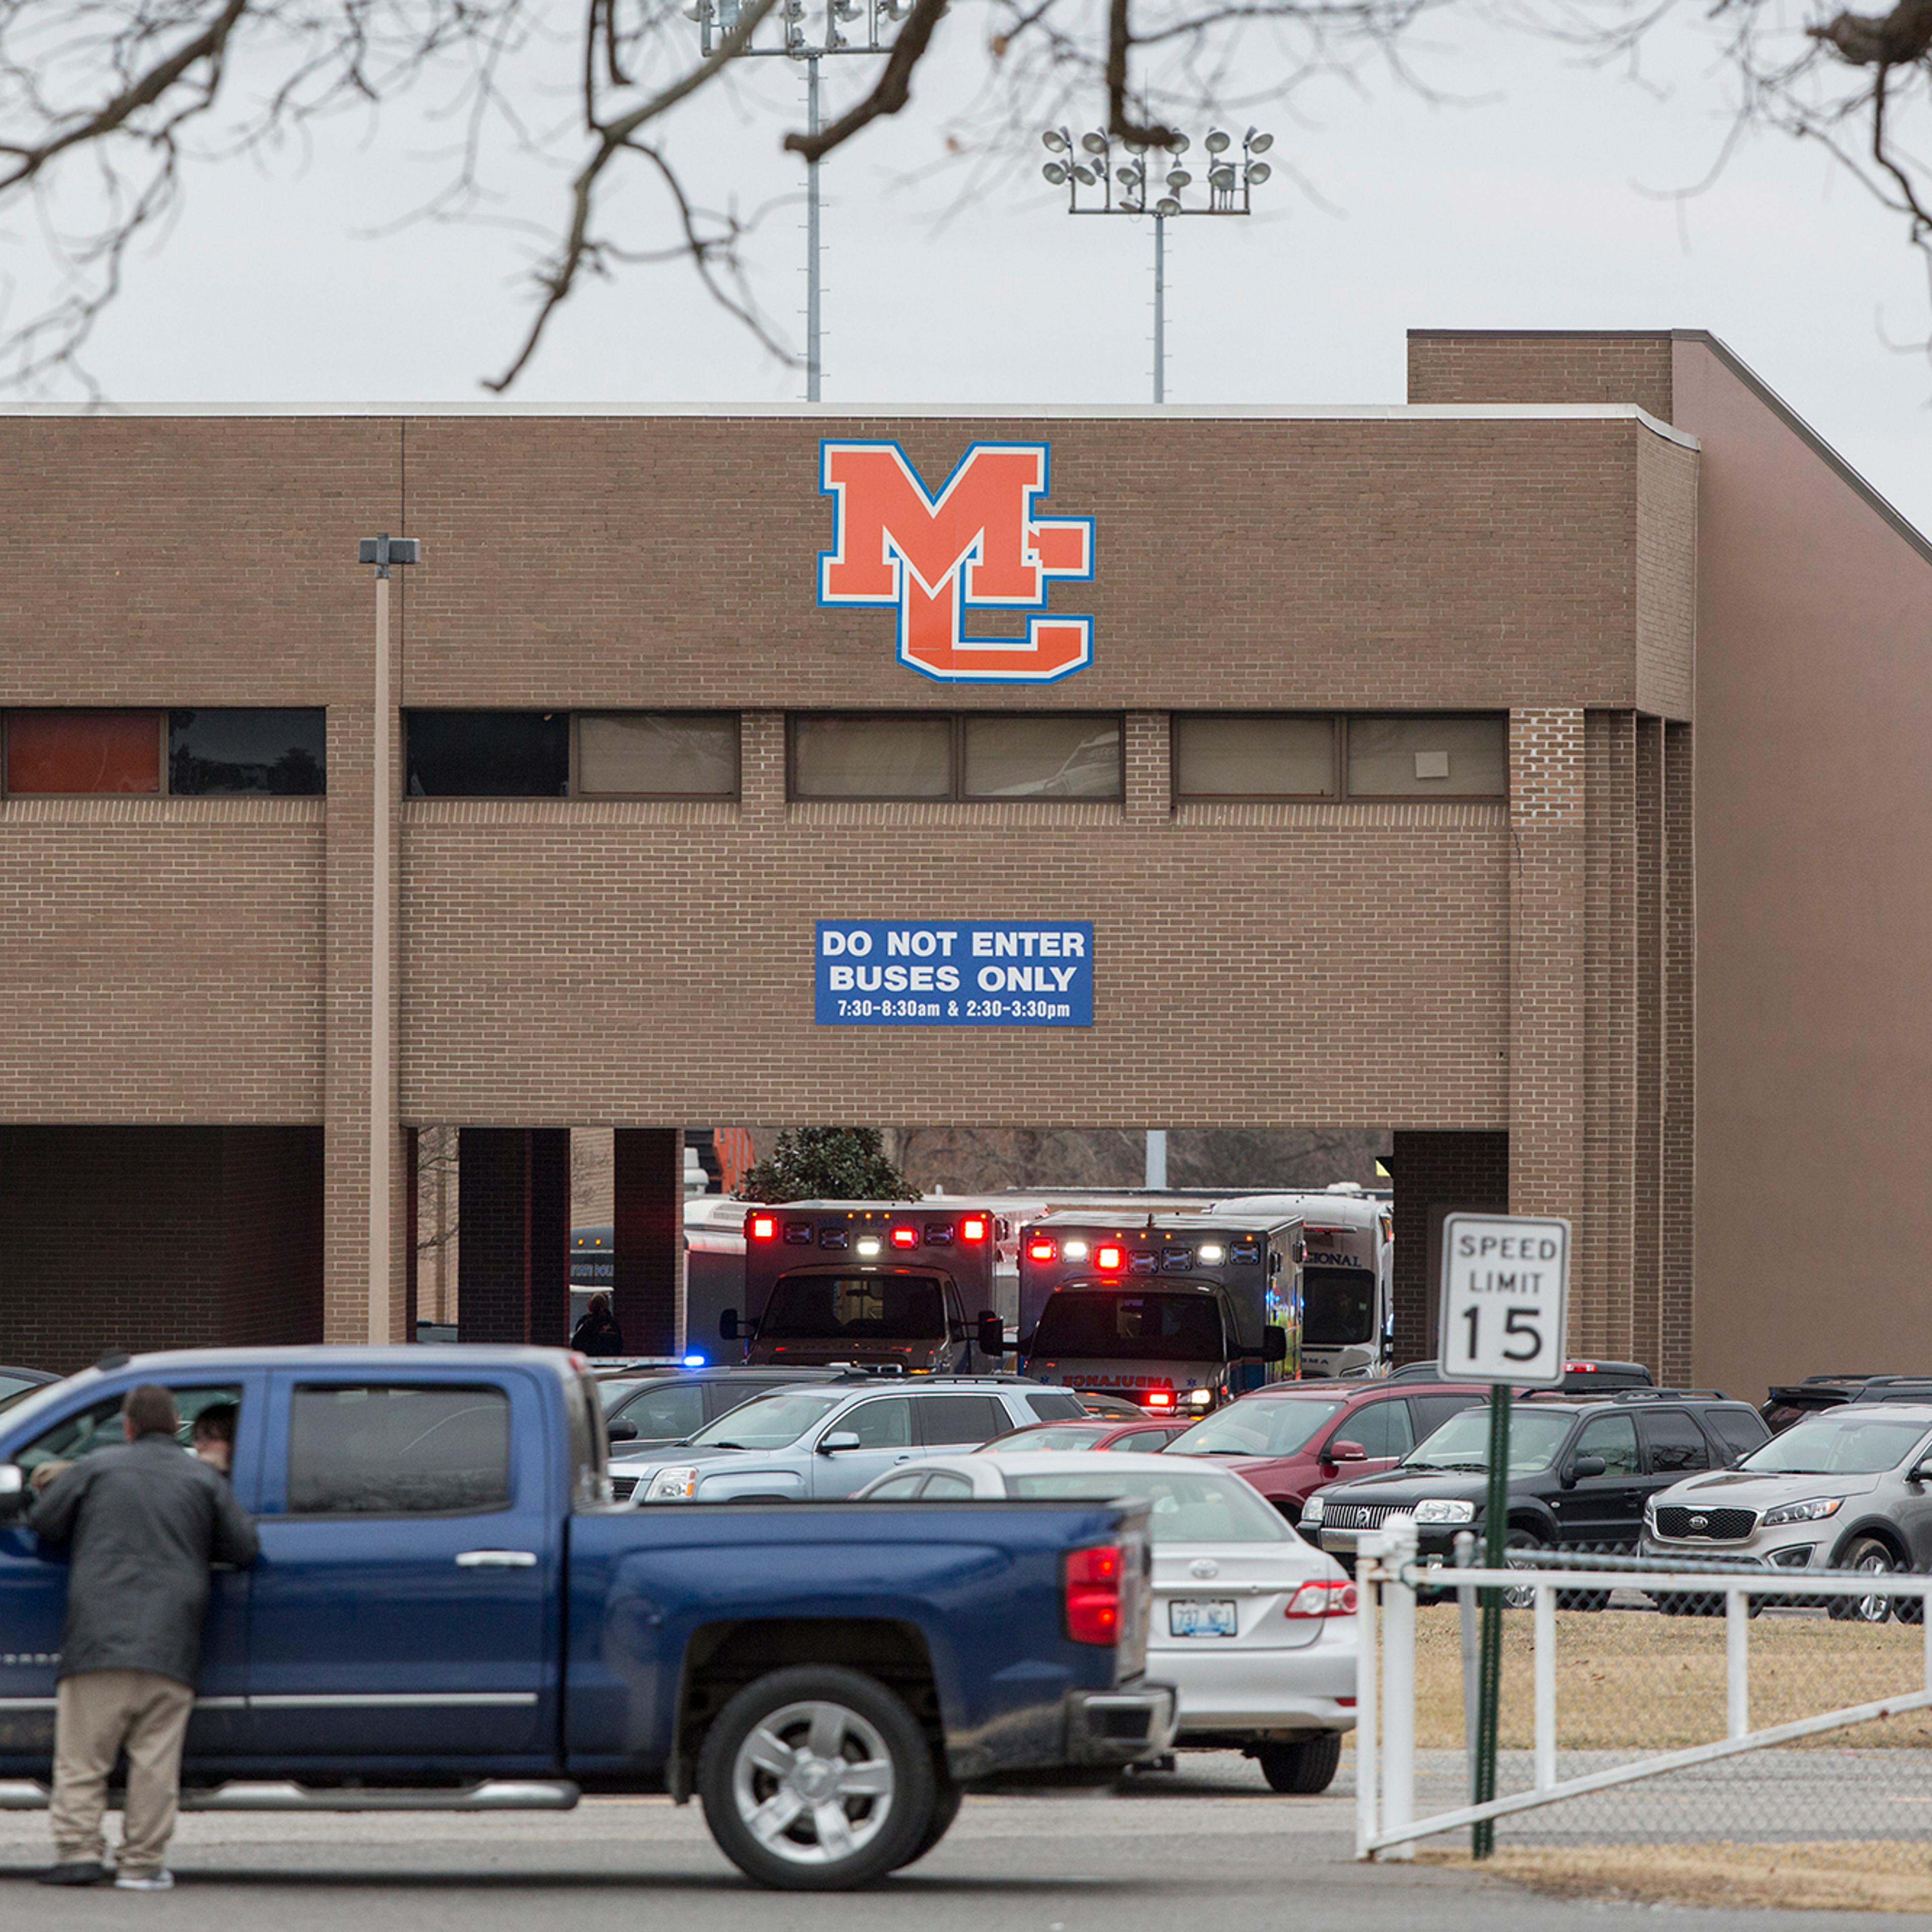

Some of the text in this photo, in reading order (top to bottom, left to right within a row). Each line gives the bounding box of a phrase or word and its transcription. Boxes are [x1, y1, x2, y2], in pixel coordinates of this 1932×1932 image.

[817, 439, 1095, 684] MC
[822, 930, 1085, 957] DO NOT ENTER
[829, 965, 1077, 992] BUSES ONLY
[838, 1000, 1071, 1020] 7:30-8:30am & 2:30-3:30pm
[1458, 1235, 1557, 1260] SPEED
[1469, 1270, 1543, 1294] LIMIT
[1463, 1305, 1542, 1361] 15
